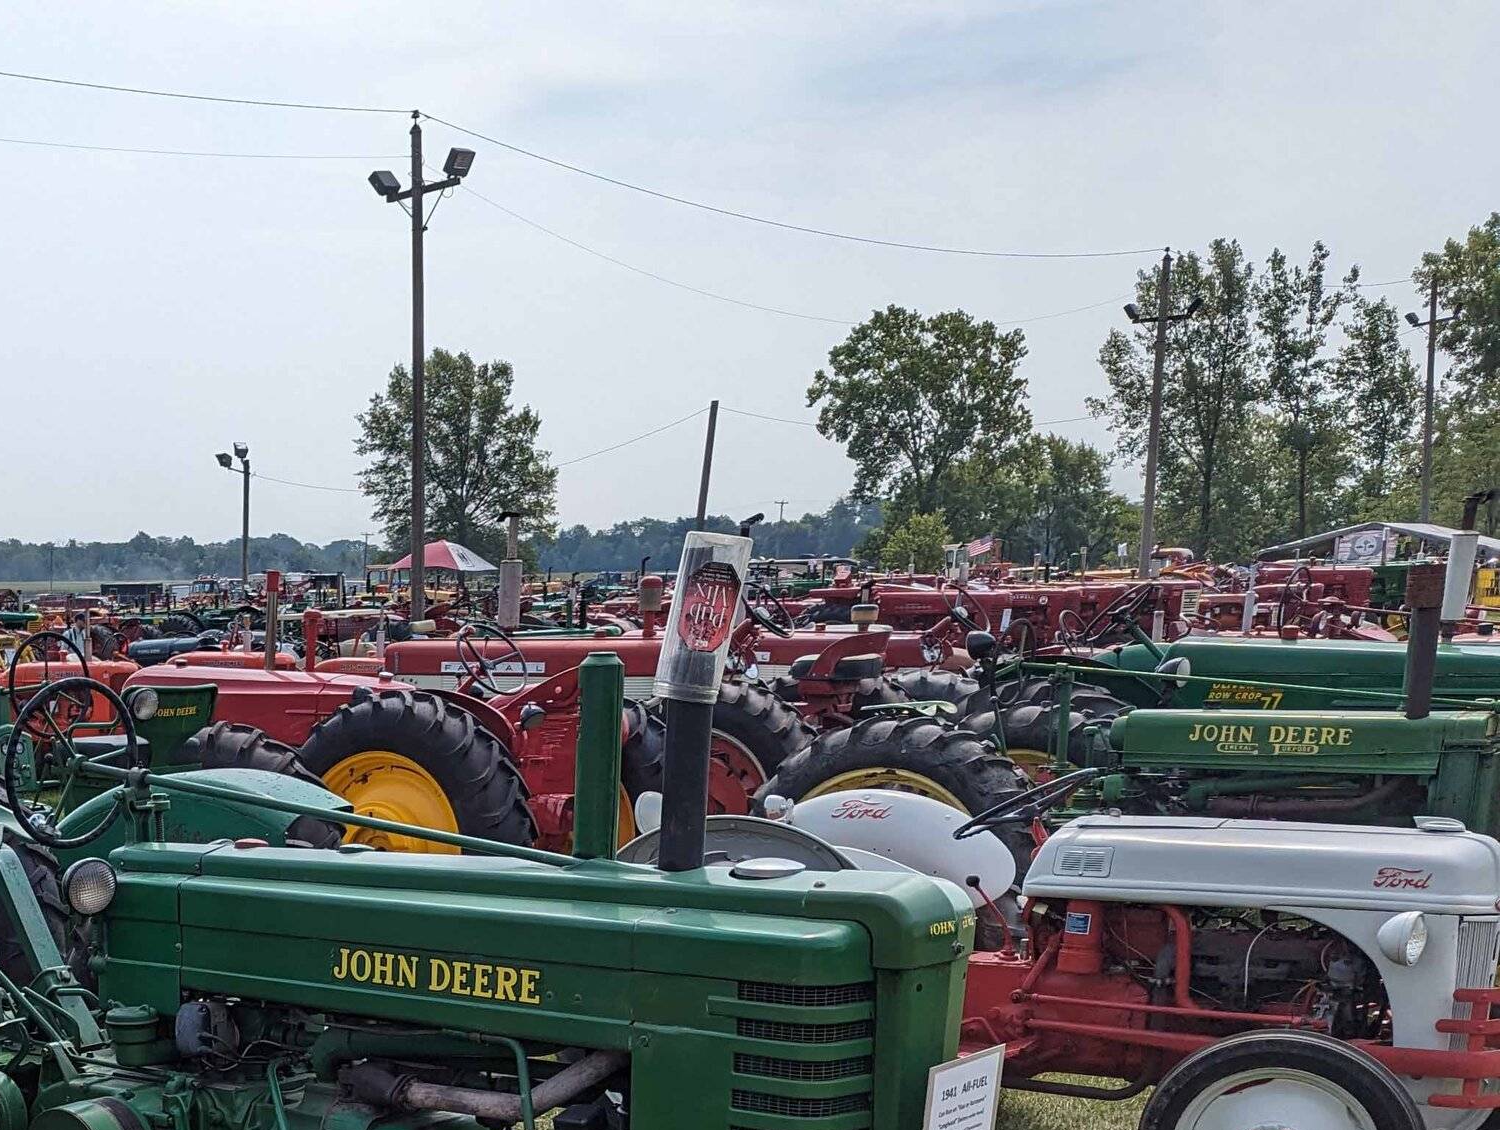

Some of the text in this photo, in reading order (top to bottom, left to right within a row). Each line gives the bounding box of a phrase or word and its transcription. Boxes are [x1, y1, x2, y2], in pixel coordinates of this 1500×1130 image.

[1235, 692, 1261, 700] CROP
[1260, 693, 1284, 709] 77
[176, 705, 197, 716] DEERE
[1188, 724, 1353, 746] JOHN DEERE
[831, 799, 894, 820] Ford
[1373, 867, 1433, 889] Ford
[333, 947, 541, 1005] JOHN DEERE
